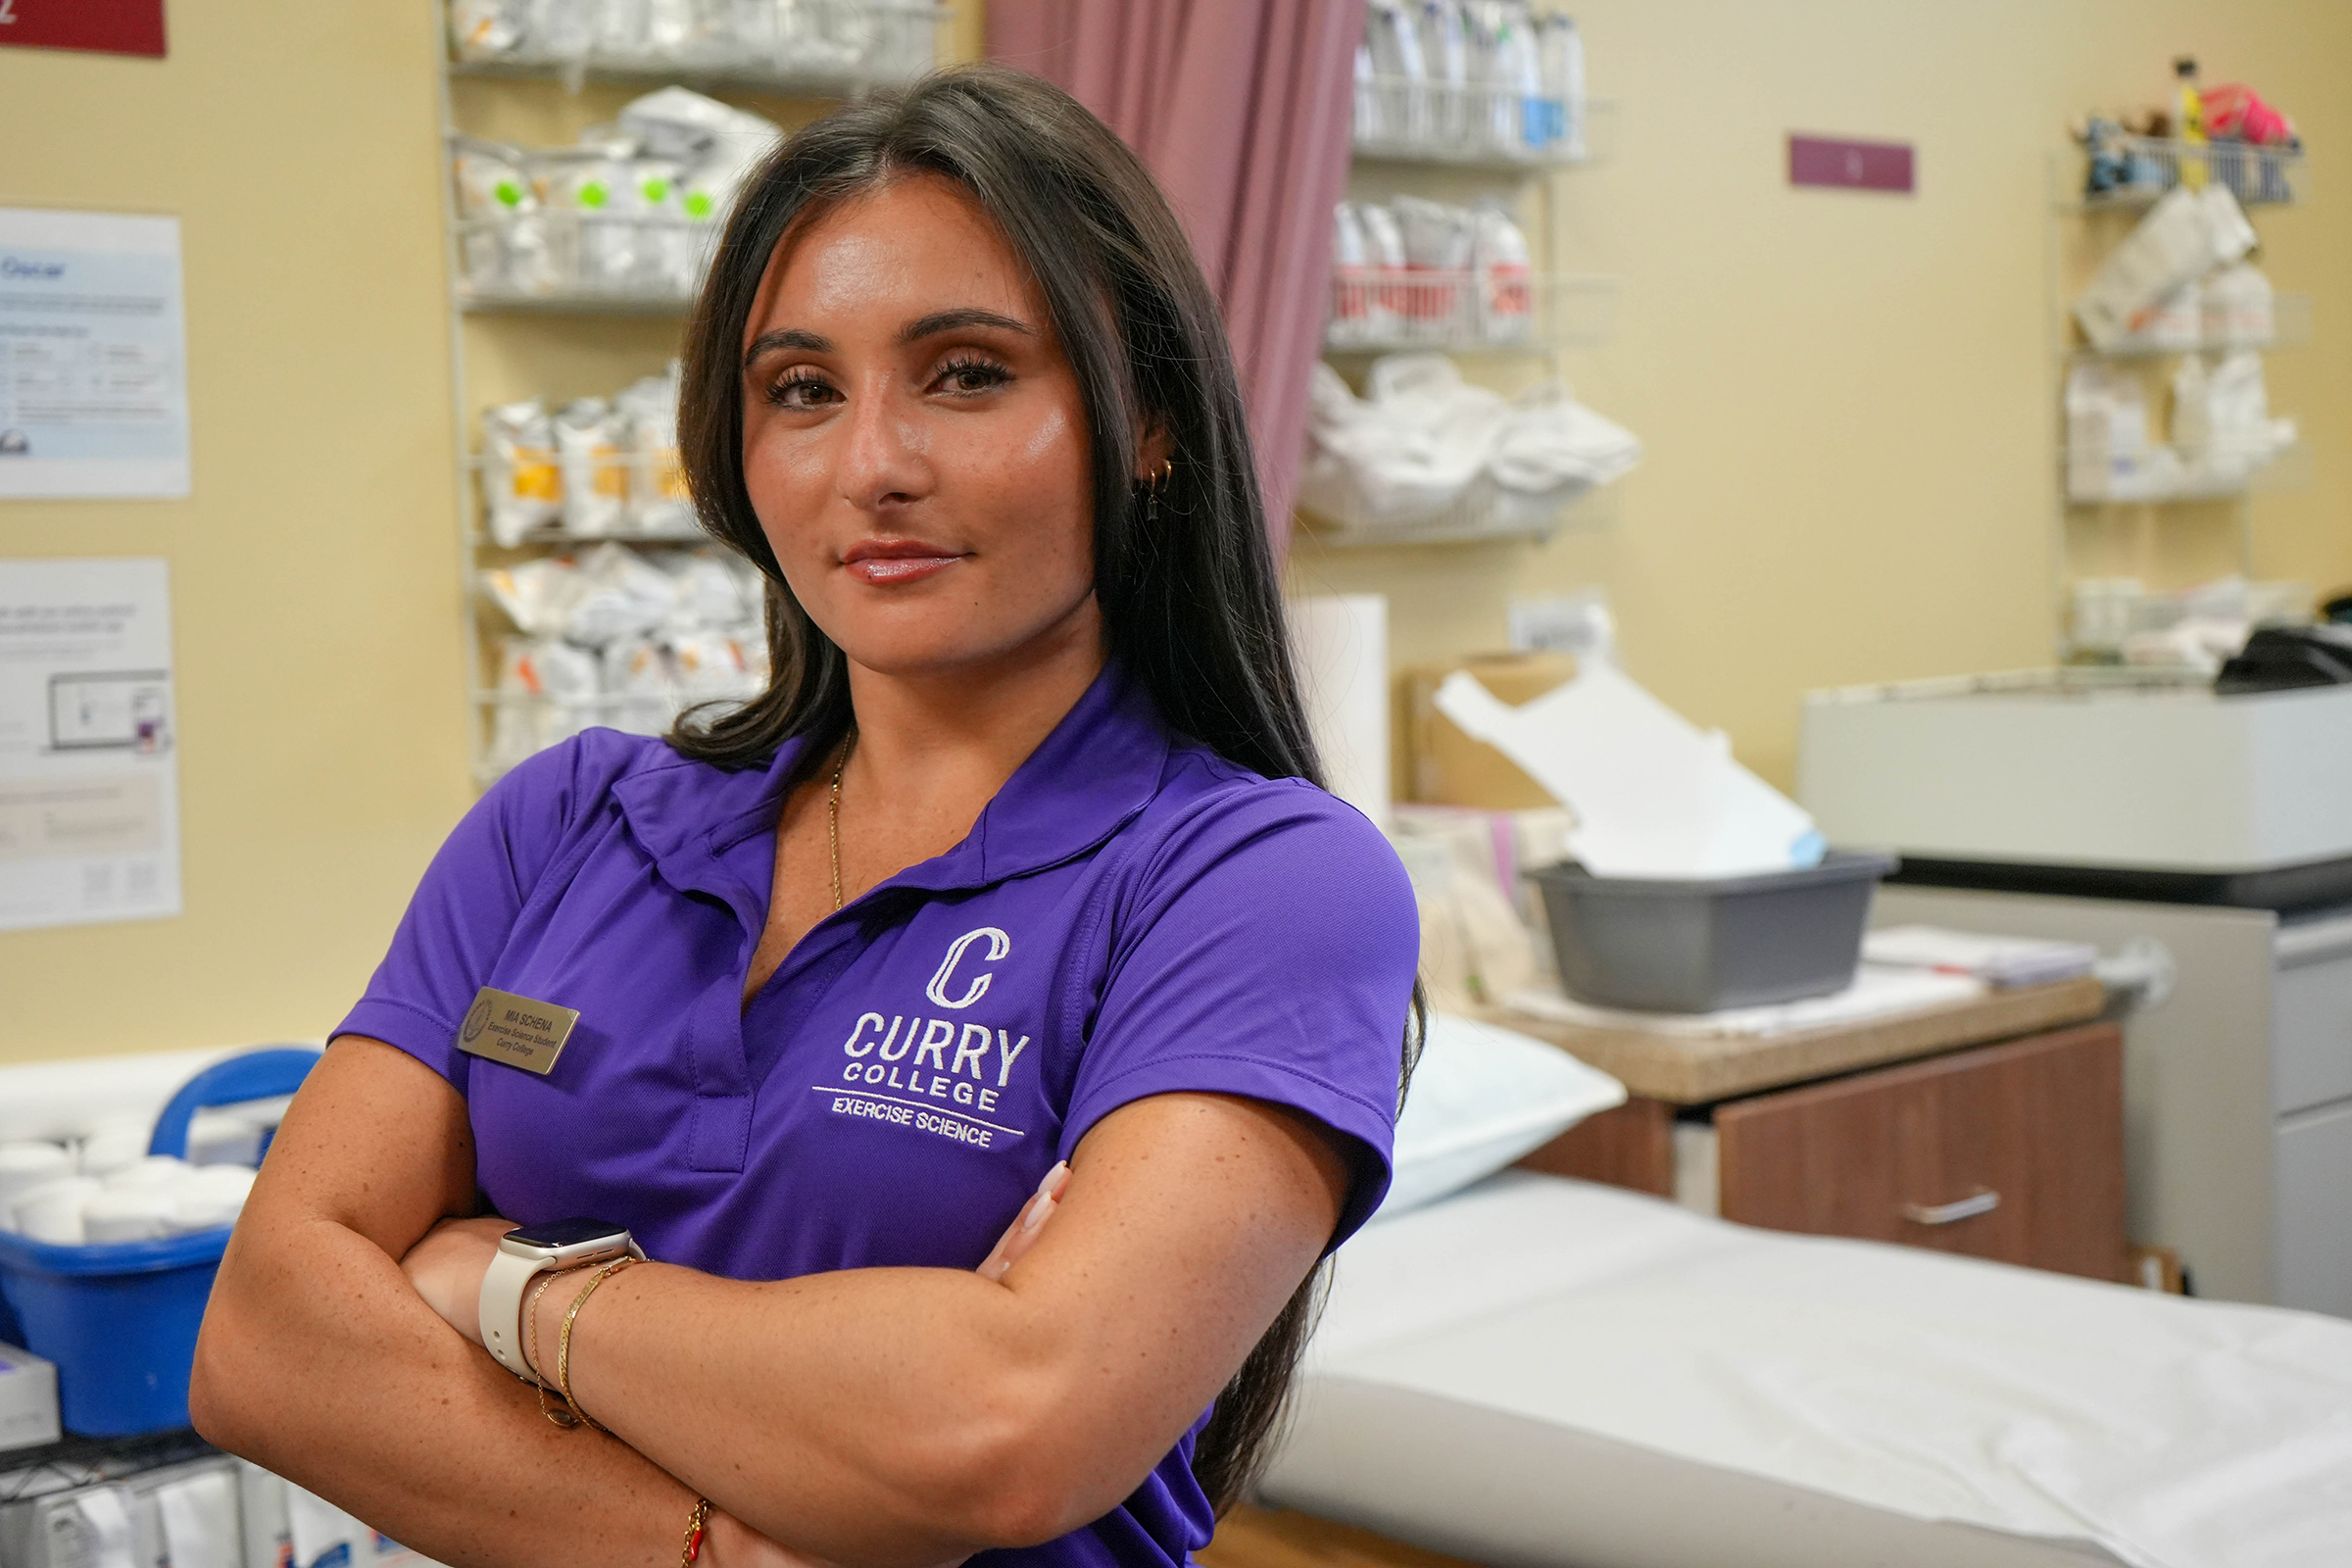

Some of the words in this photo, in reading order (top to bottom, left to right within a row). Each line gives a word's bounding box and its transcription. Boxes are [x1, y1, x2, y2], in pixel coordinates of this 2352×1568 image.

[926, 926, 1010, 1009] C
[488, 1021, 512, 1035] Exercise
[511, 1028, 533, 1042] Science
[533, 1034, 557, 1049] Student
[504, 1009, 520, 1024] MIA
[519, 1013, 553, 1032] SCHENA
[497, 1038, 513, 1052] Curry
[513, 1042, 534, 1056] College
[844, 1012, 1030, 1087] CURRY
[843, 1062, 1000, 1112] COLLEGE
[832, 1097, 913, 1126] EXERCISE
[915, 1111, 994, 1149] SCIENCE
